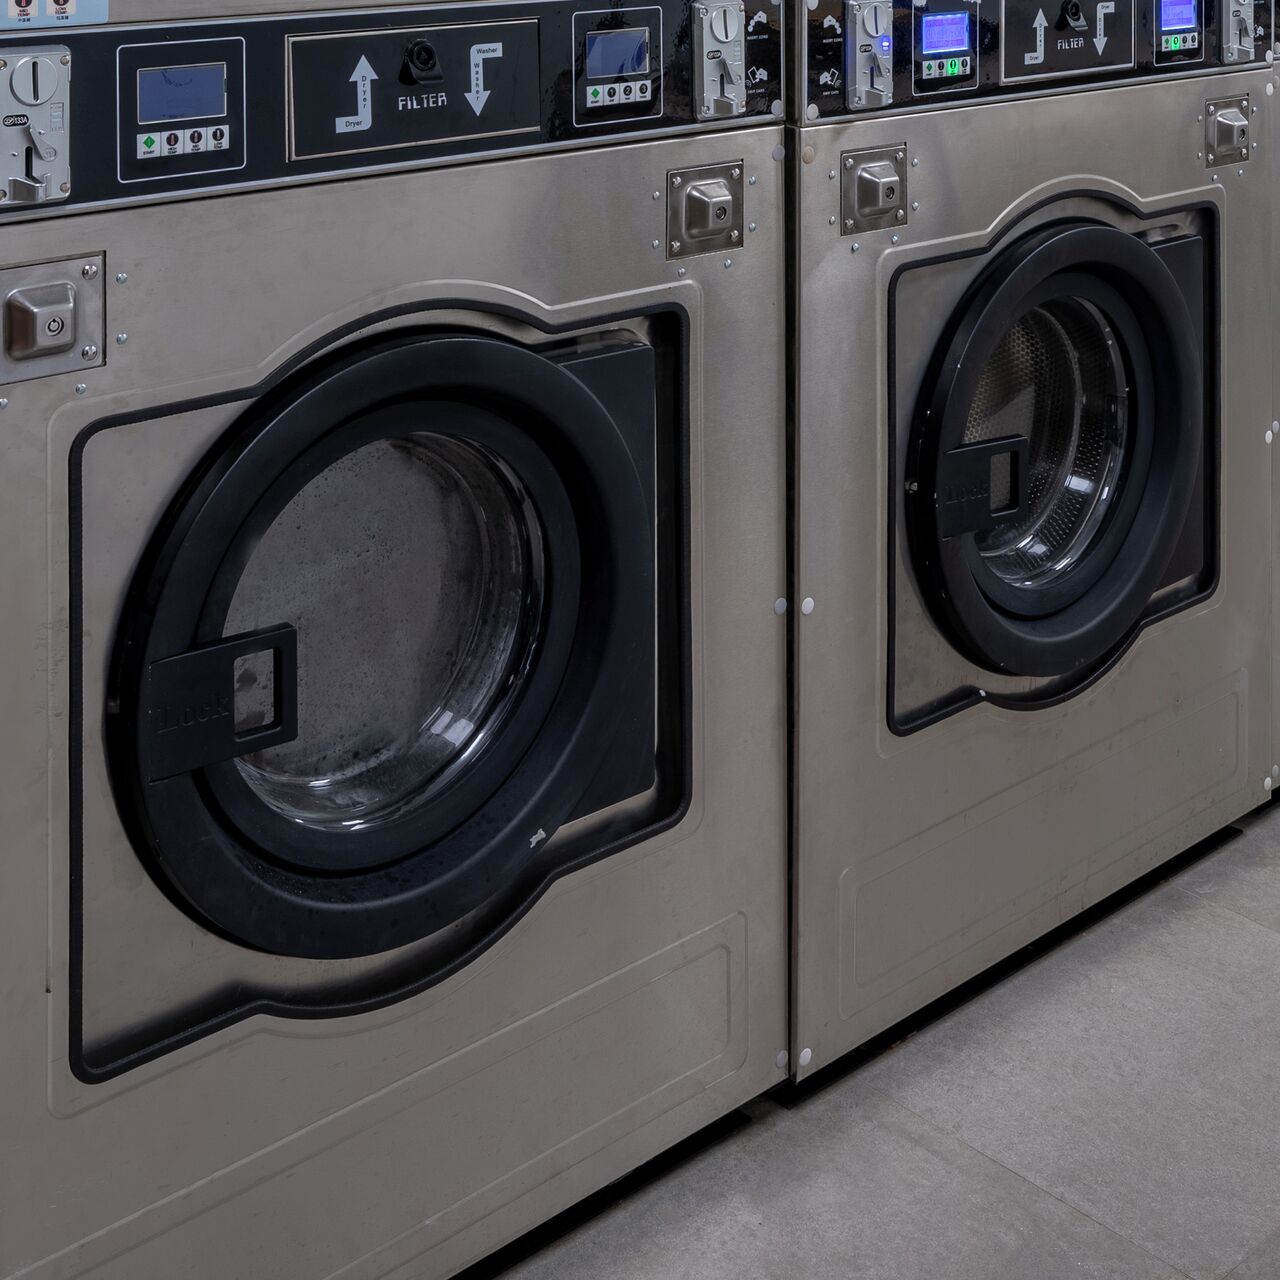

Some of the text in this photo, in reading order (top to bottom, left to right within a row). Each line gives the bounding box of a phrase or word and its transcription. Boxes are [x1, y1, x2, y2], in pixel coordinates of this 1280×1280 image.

[1057, 37, 1084, 50] FILTER
[398, 92, 447, 111] FILTER
[345, 120, 362, 128] Dryer
[157, 692, 231, 734] Lock
